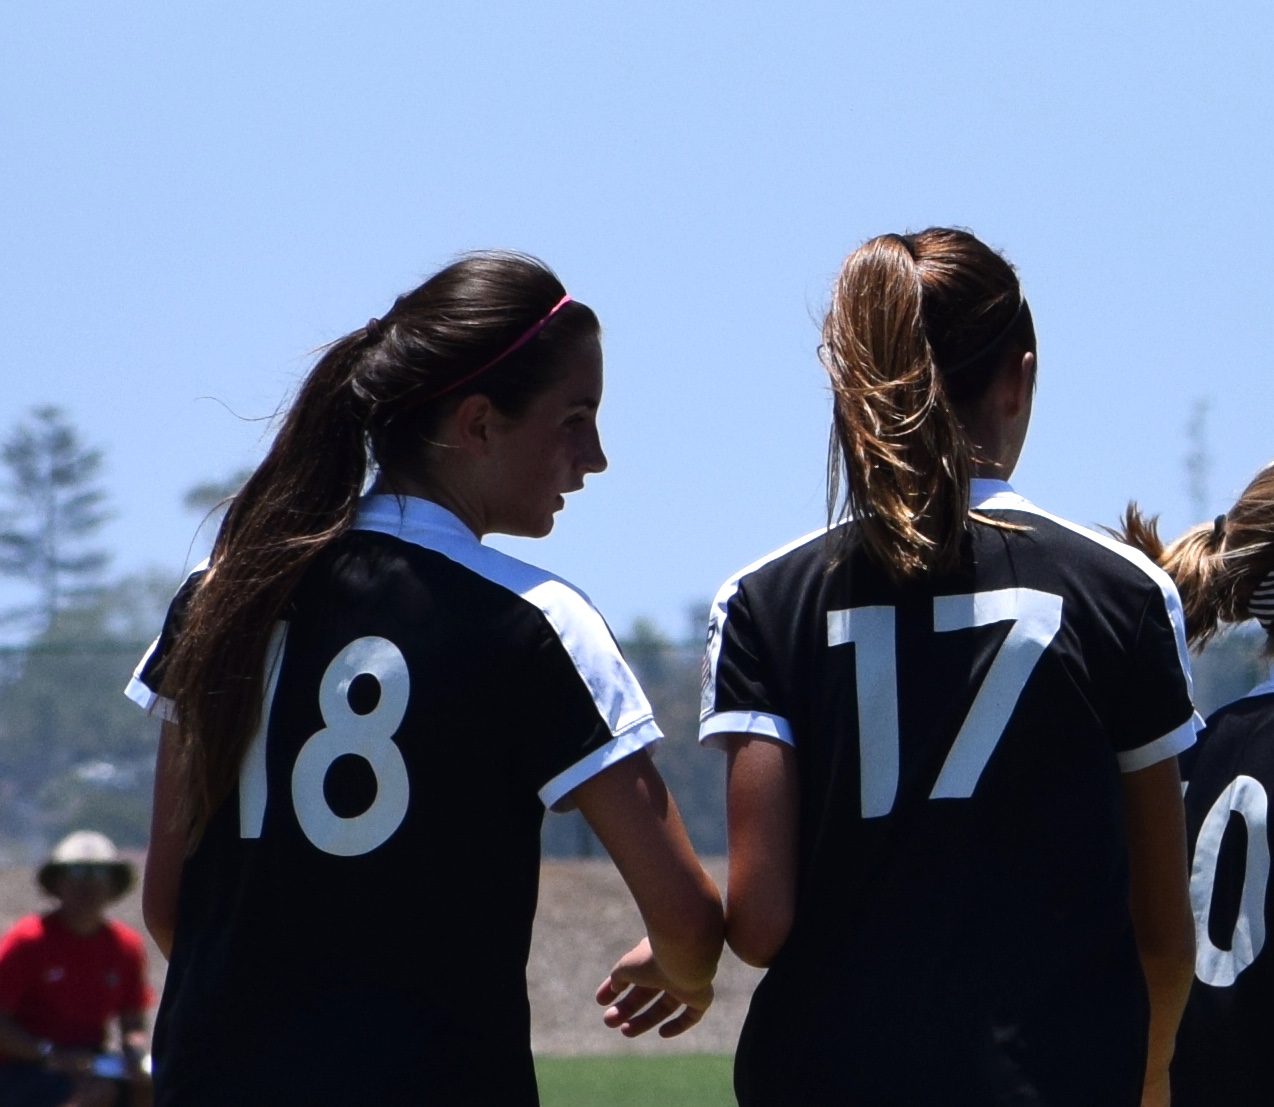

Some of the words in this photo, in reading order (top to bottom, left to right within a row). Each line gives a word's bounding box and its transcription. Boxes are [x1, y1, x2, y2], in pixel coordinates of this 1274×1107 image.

[238, 620, 410, 857] 18
[826, 587, 1064, 819] 17
[1181, 775, 1271, 988] 0
